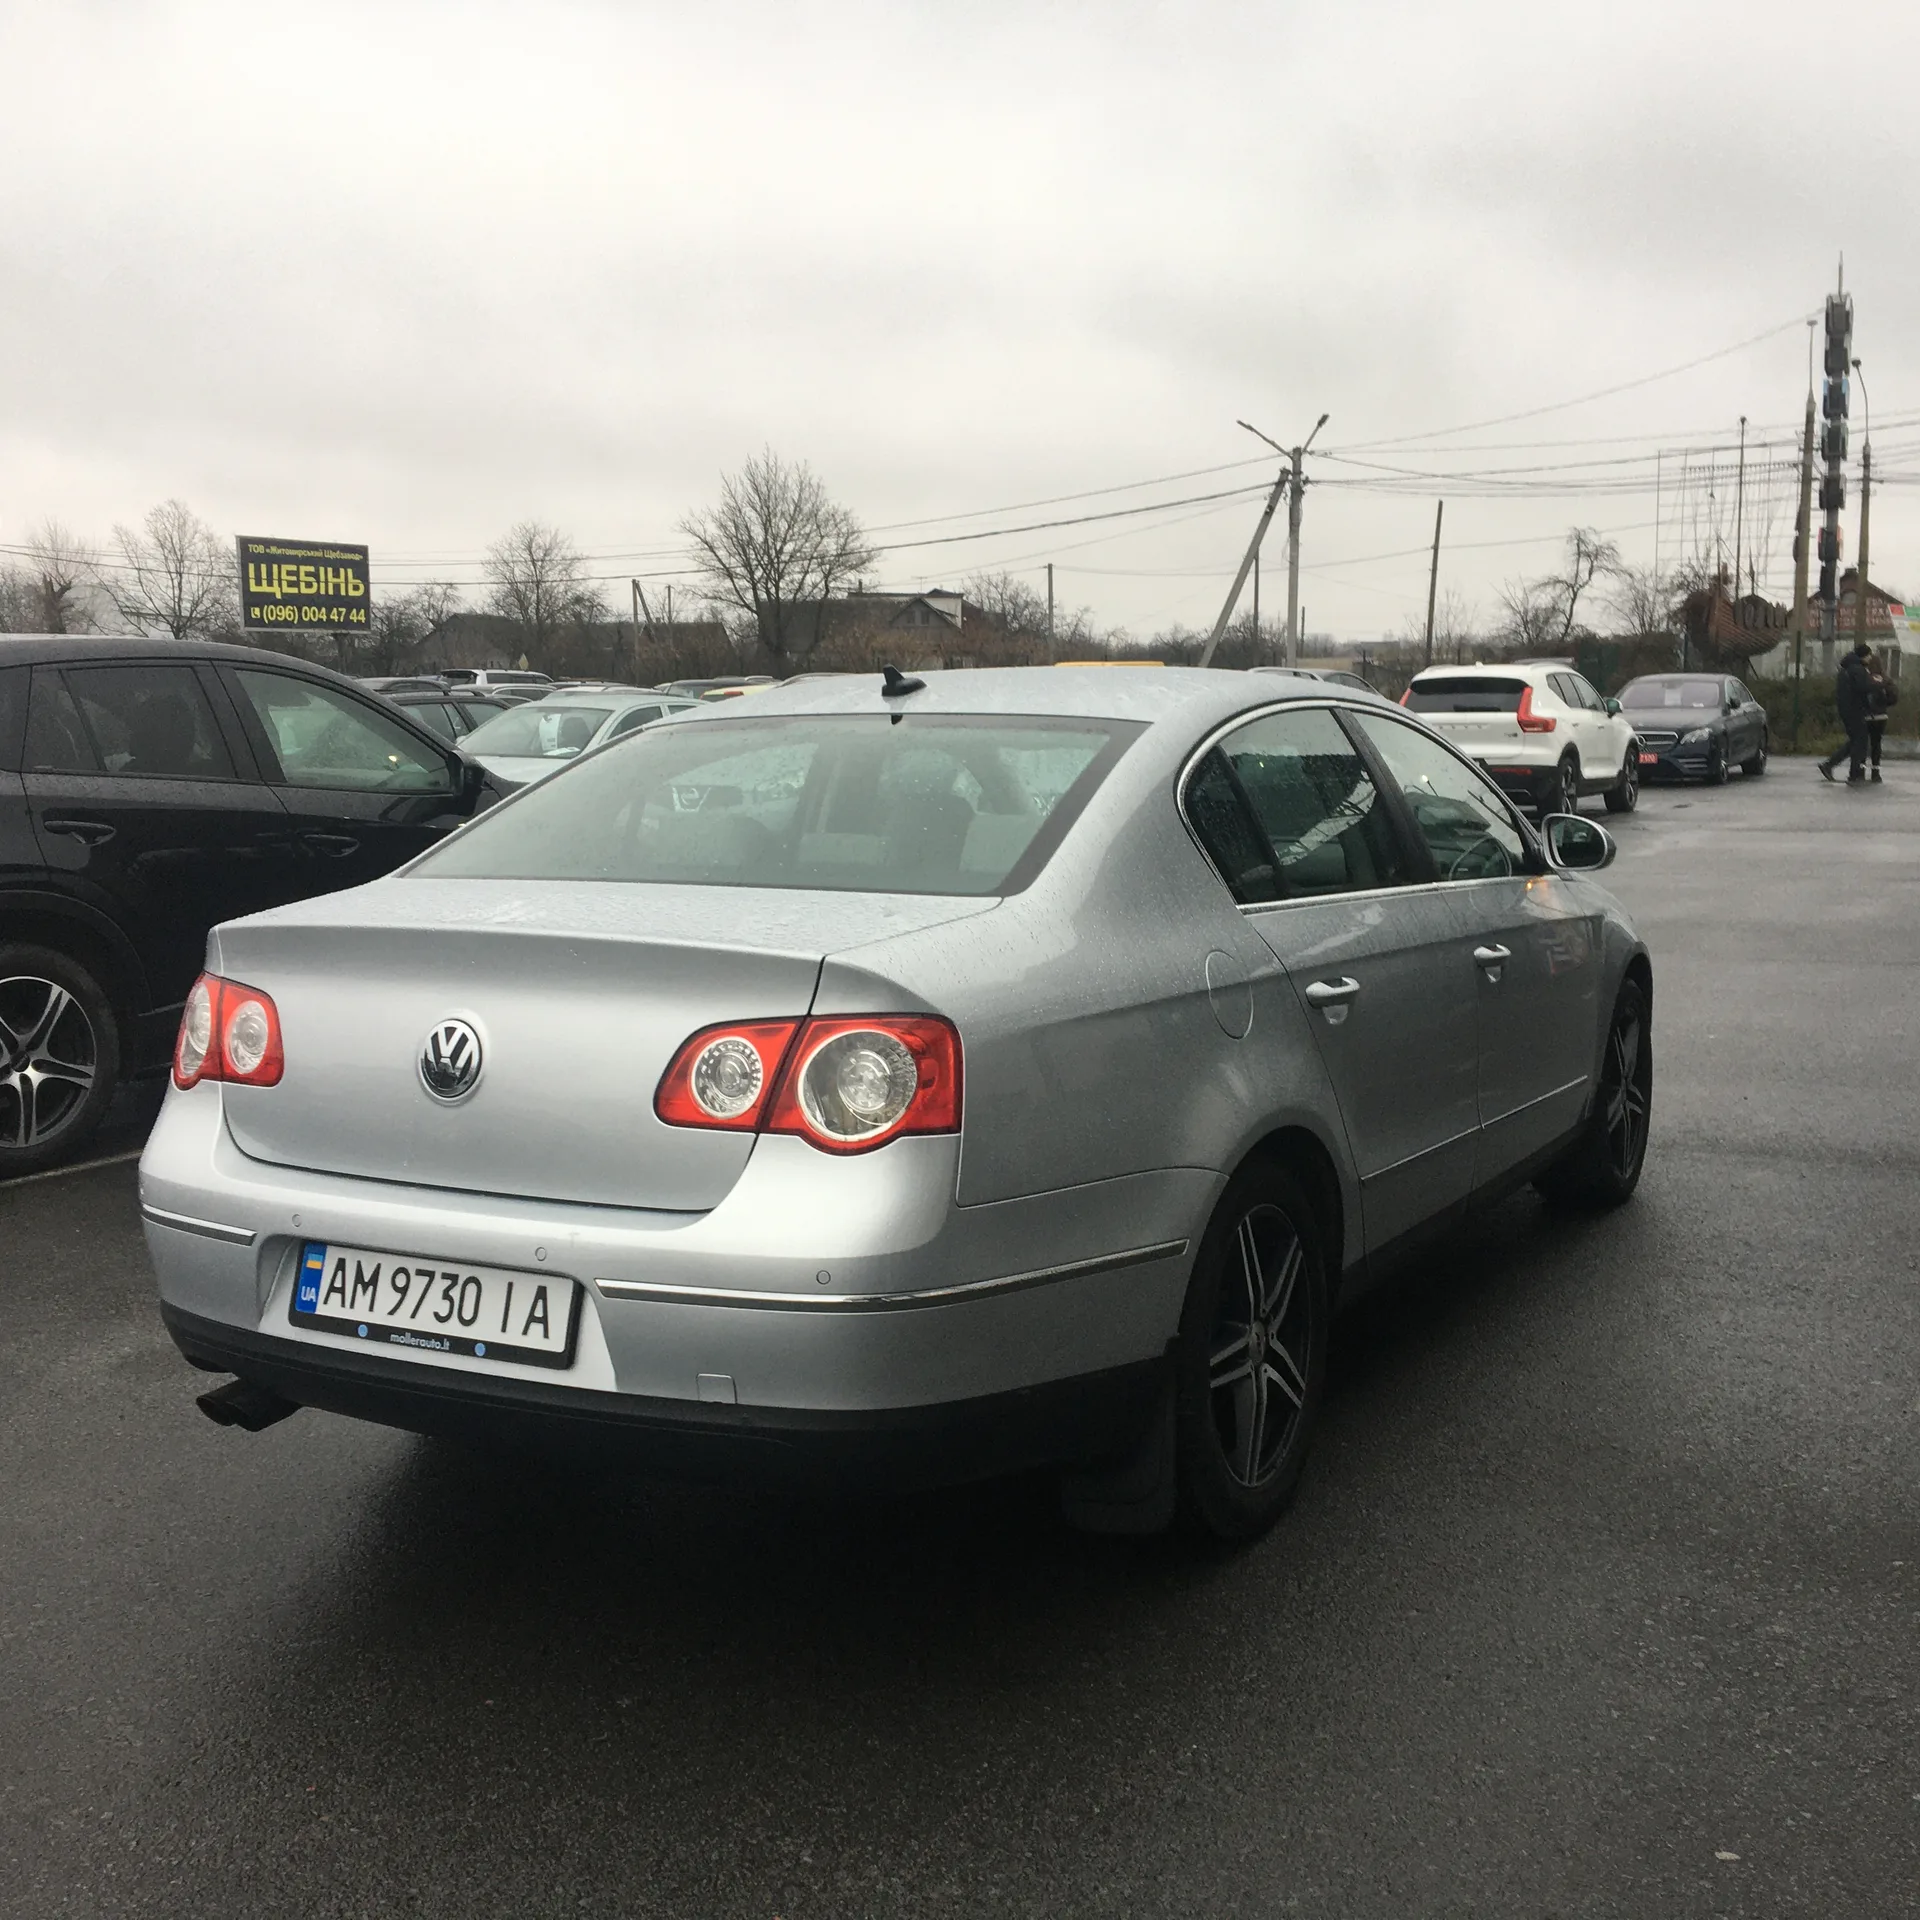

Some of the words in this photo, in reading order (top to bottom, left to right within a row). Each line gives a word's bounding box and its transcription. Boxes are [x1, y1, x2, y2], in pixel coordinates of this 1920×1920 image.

[248, 544, 265, 554] ТОВ
[248, 562, 365, 600] ЩЕБІНЬ
[262, 604, 299, 624] (096)
[302, 606, 327, 622] 004
[330, 607, 347, 623] 47
[349, 608, 366, 623] 44
[300, 1285, 318, 1303] UA
[322, 1257, 382, 1313] AM
[386, 1266, 483, 1327] 9730
[500, 1281, 551, 1340] IA
[390, 1331, 450, 1350] mollerauto.lt
